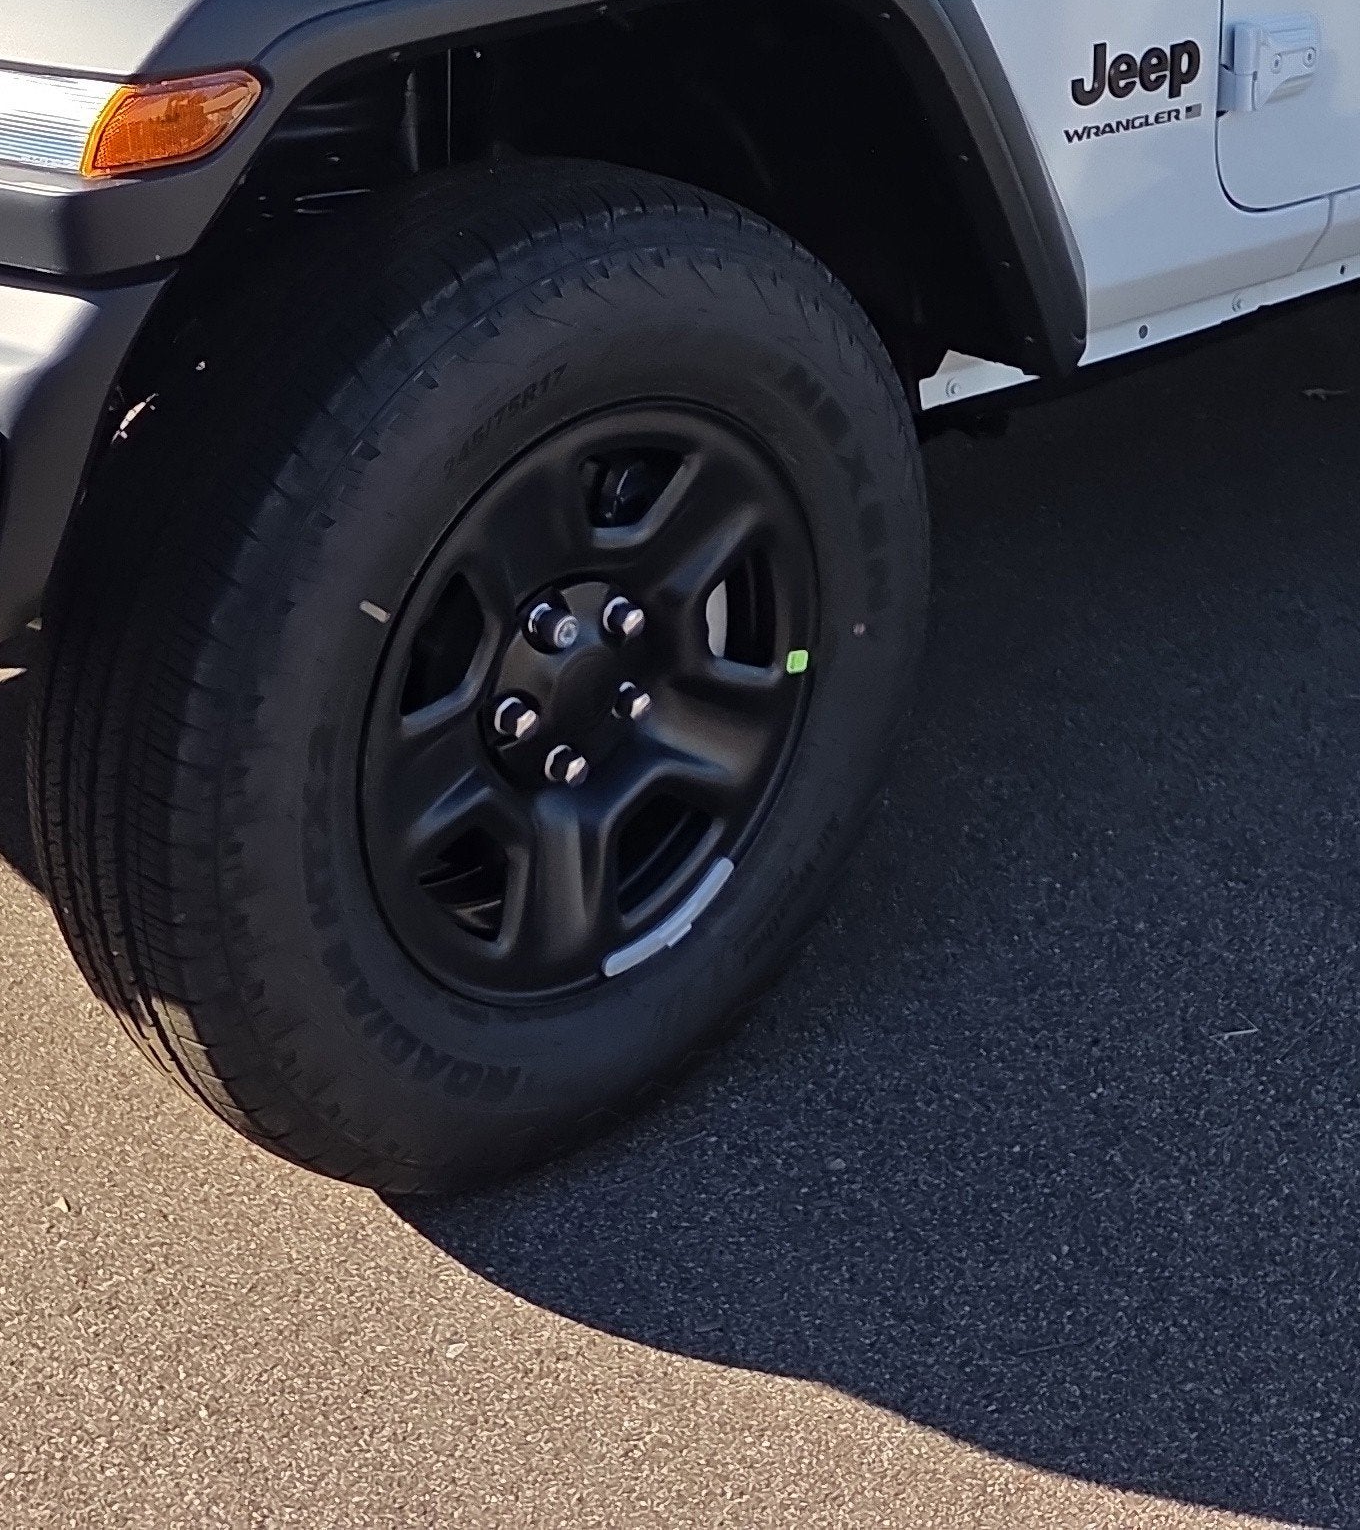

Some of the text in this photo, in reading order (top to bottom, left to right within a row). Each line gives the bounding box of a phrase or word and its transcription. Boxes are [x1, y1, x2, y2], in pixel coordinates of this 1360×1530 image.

[1071, 40, 1201, 106] Jeep
[1063, 108, 1181, 144] WRANGLER
[441, 363, 568, 481] 245/75R17
